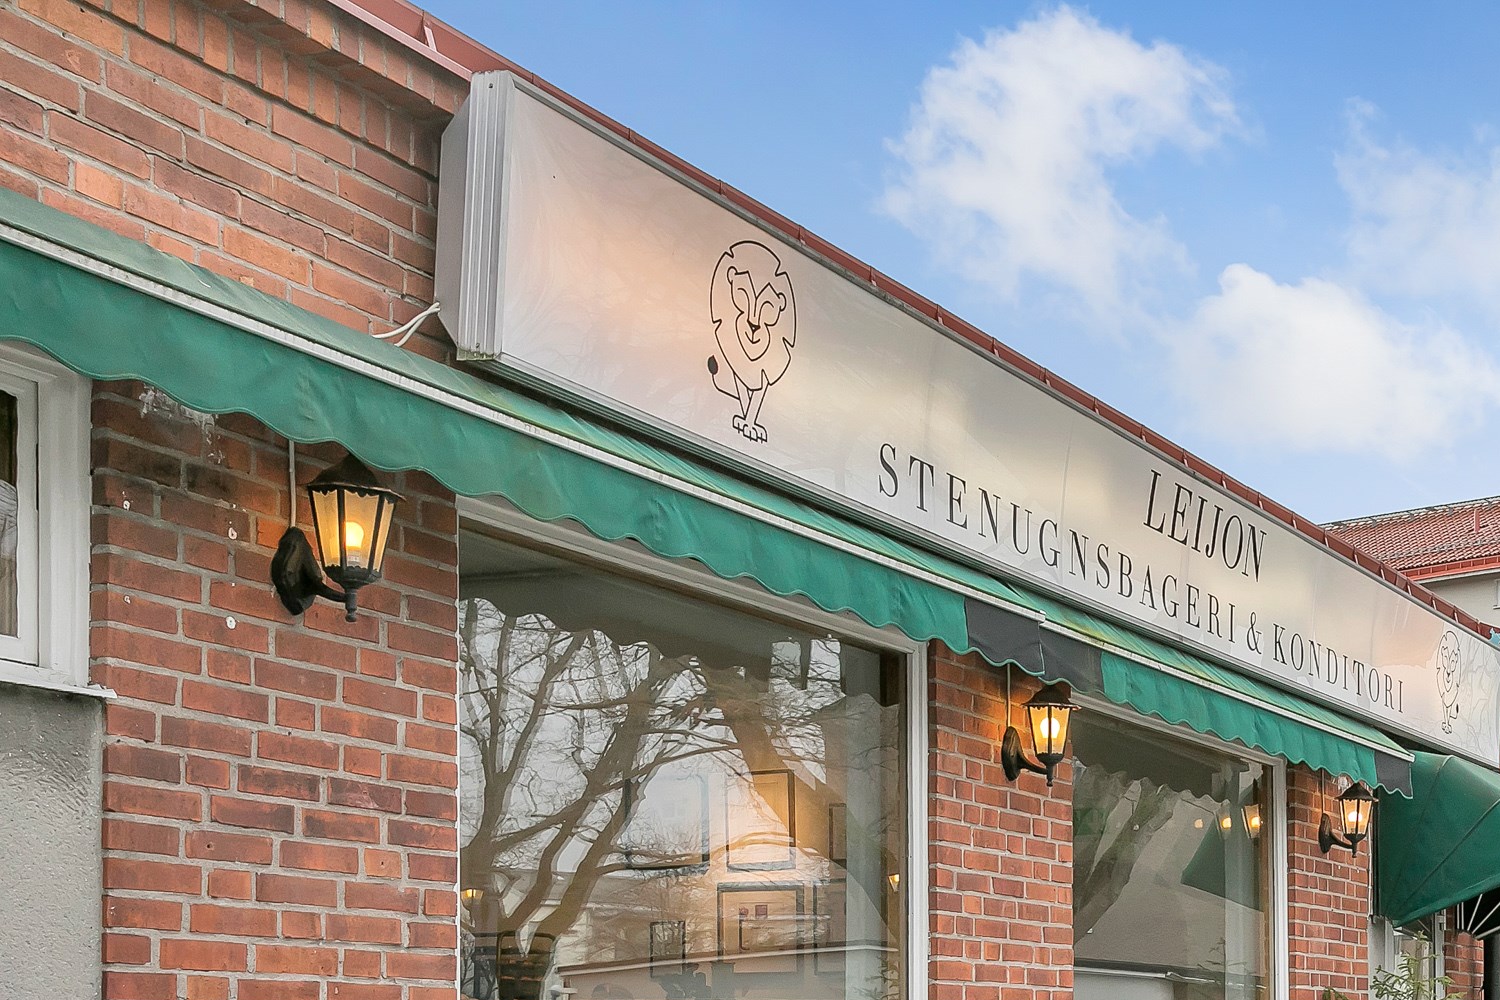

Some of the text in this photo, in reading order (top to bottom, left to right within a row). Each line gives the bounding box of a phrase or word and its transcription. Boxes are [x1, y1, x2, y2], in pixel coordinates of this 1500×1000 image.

[877, 442, 1404, 714] STENUGNSBAGERI & KONDITORI
[1143, 468, 1267, 583] LEIJON
